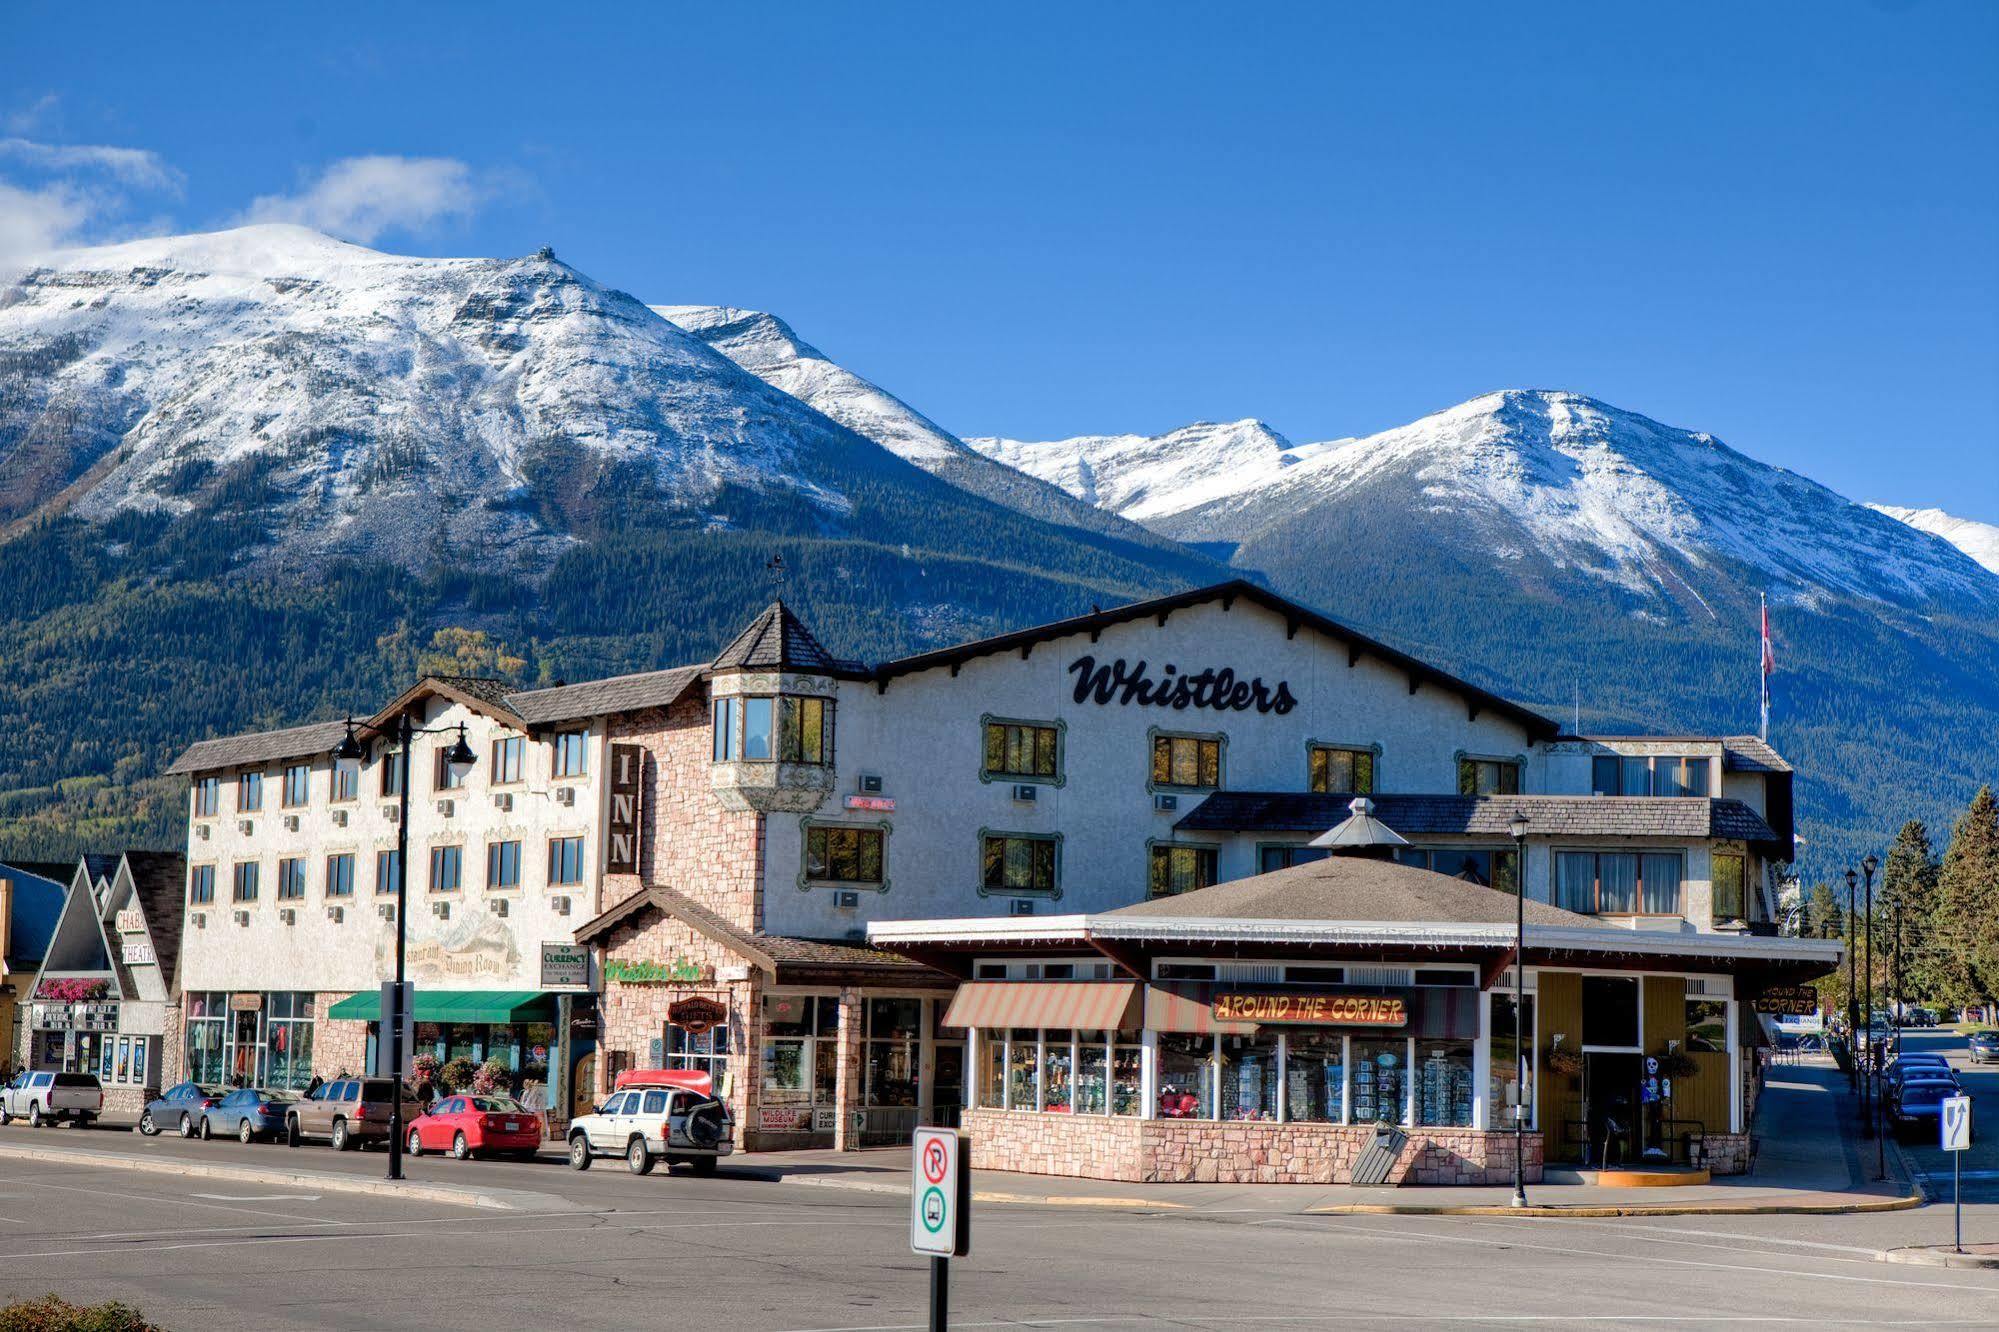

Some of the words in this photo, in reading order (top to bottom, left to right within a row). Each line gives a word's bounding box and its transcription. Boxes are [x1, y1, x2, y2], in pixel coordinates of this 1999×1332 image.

[1068, 656, 1298, 714] Whistlers
[611, 754, 635, 863] INN
[406, 946, 439, 962] staurant
[475, 953, 500, 974] Room
[1216, 995, 1290, 1018] AROUND
[1295, 997, 1327, 1019] THE
[1331, 999, 1402, 1021] CORNER
[1758, 998, 1815, 1013] CORNER
[761, 1109, 797, 1117] WILDLIFE
